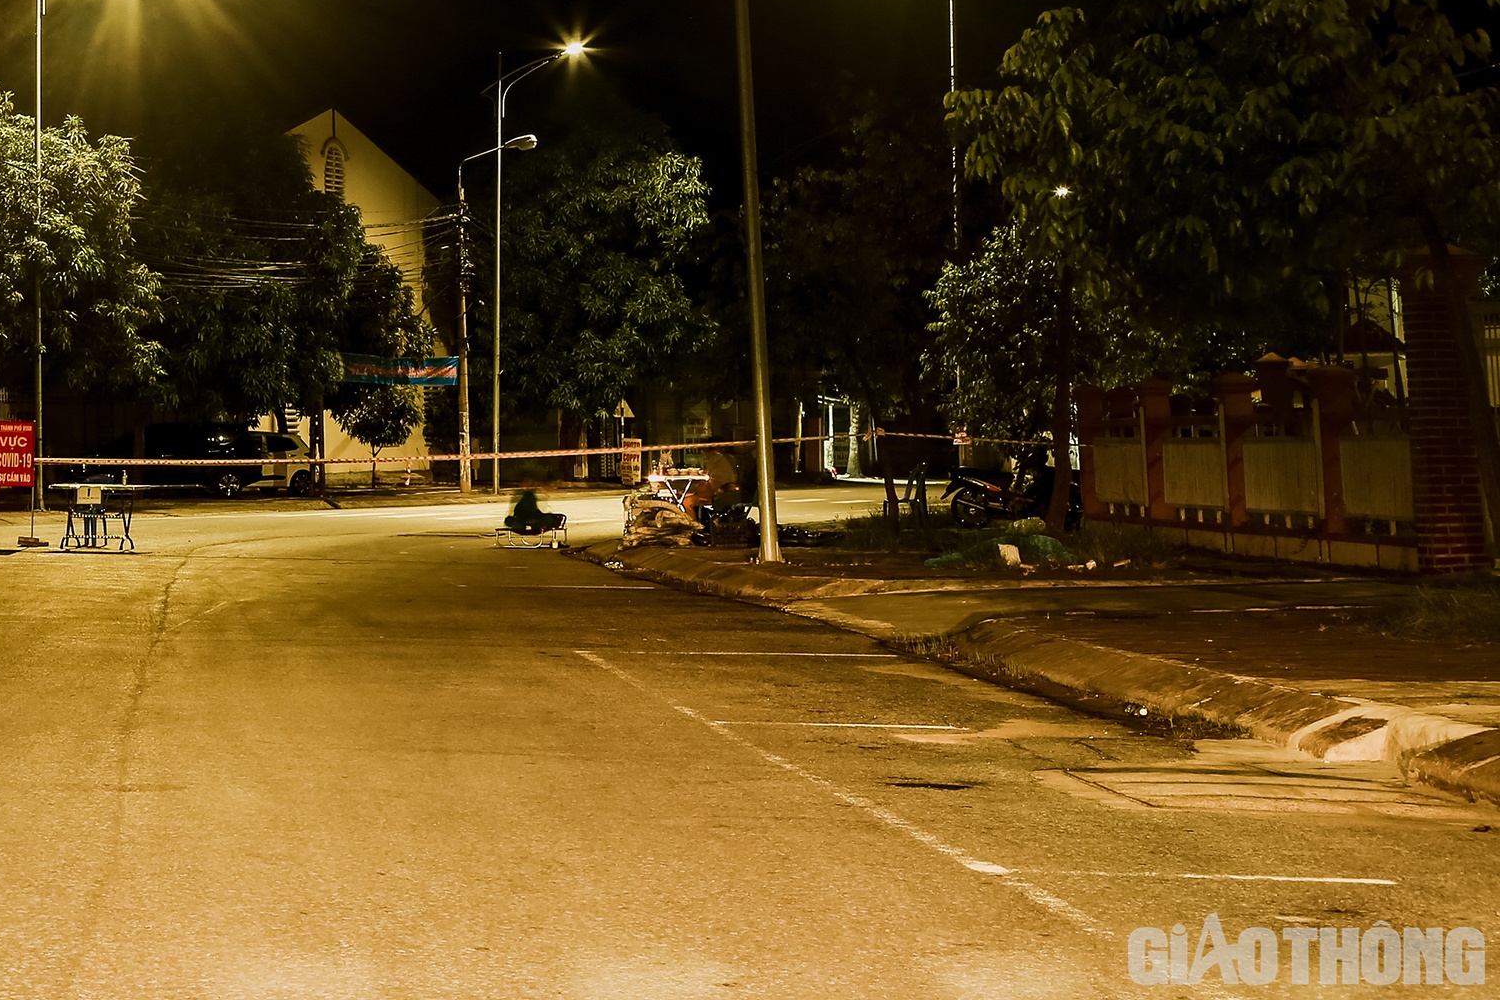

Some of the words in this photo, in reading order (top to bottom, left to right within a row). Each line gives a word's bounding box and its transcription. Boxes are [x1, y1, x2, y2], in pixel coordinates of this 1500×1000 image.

[0, 435, 28, 450] VỰC
[6, 470, 19, 482] CẤM
[20, 471, 31, 483] VÀO
